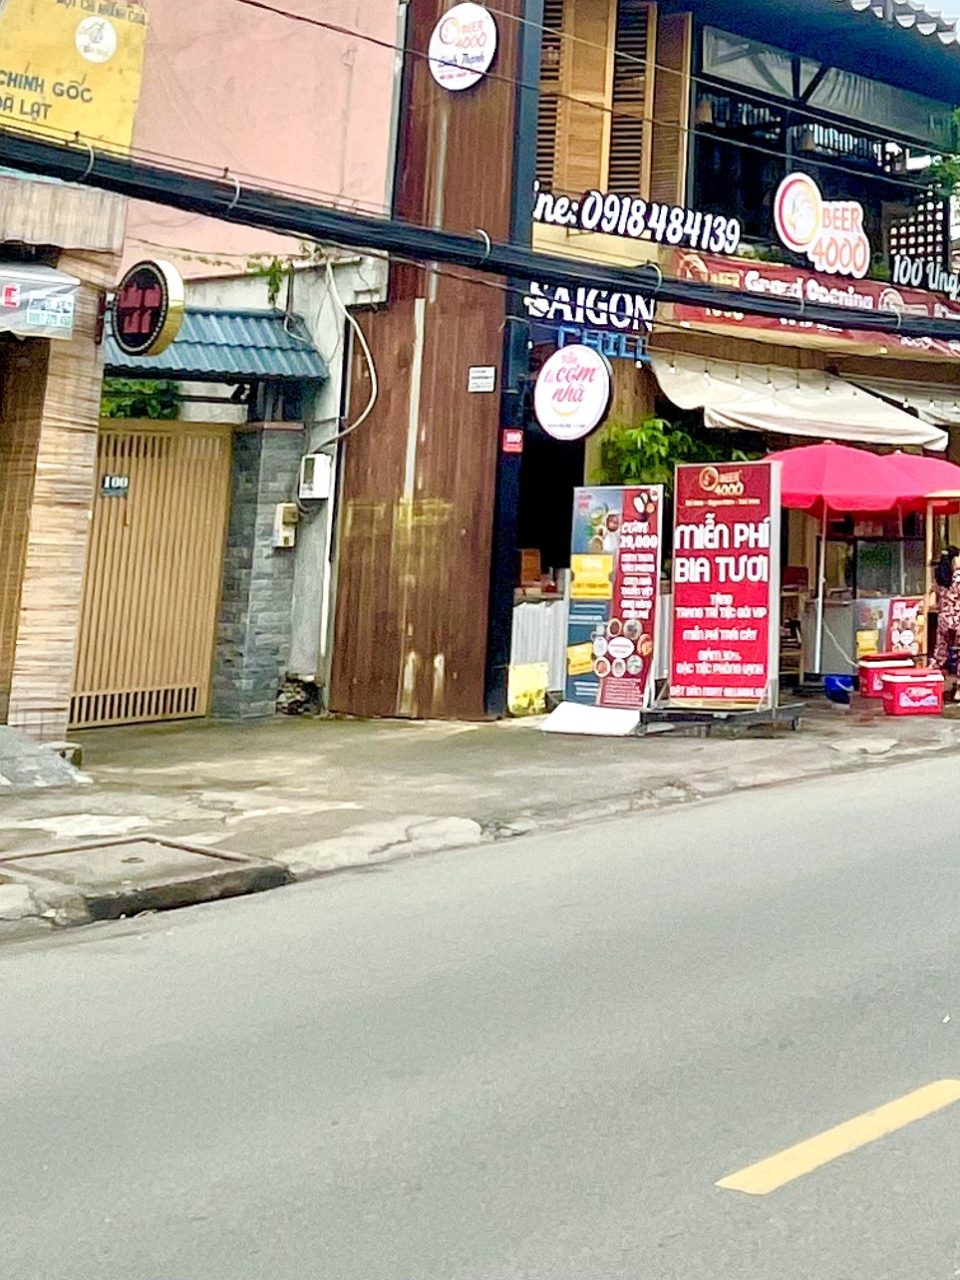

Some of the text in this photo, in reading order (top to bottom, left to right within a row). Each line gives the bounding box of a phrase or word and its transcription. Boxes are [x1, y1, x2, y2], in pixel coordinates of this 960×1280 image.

[52, 73, 94, 103] GỐC
[20, 99, 52, 121] LẠT
[822, 207, 861, 234] BEER
[811, 235, 867, 272] 4000
[523, 281, 655, 331] SAIGON
[556, 364, 597, 383] cơm
[552, 383, 584, 403] nhà
[104, 475, 129, 488] 100
[674, 513, 771, 550] MIỄN PHÍ
[674, 557, 711, 583] BIA
[715, 554, 769, 583] TƯƠI
